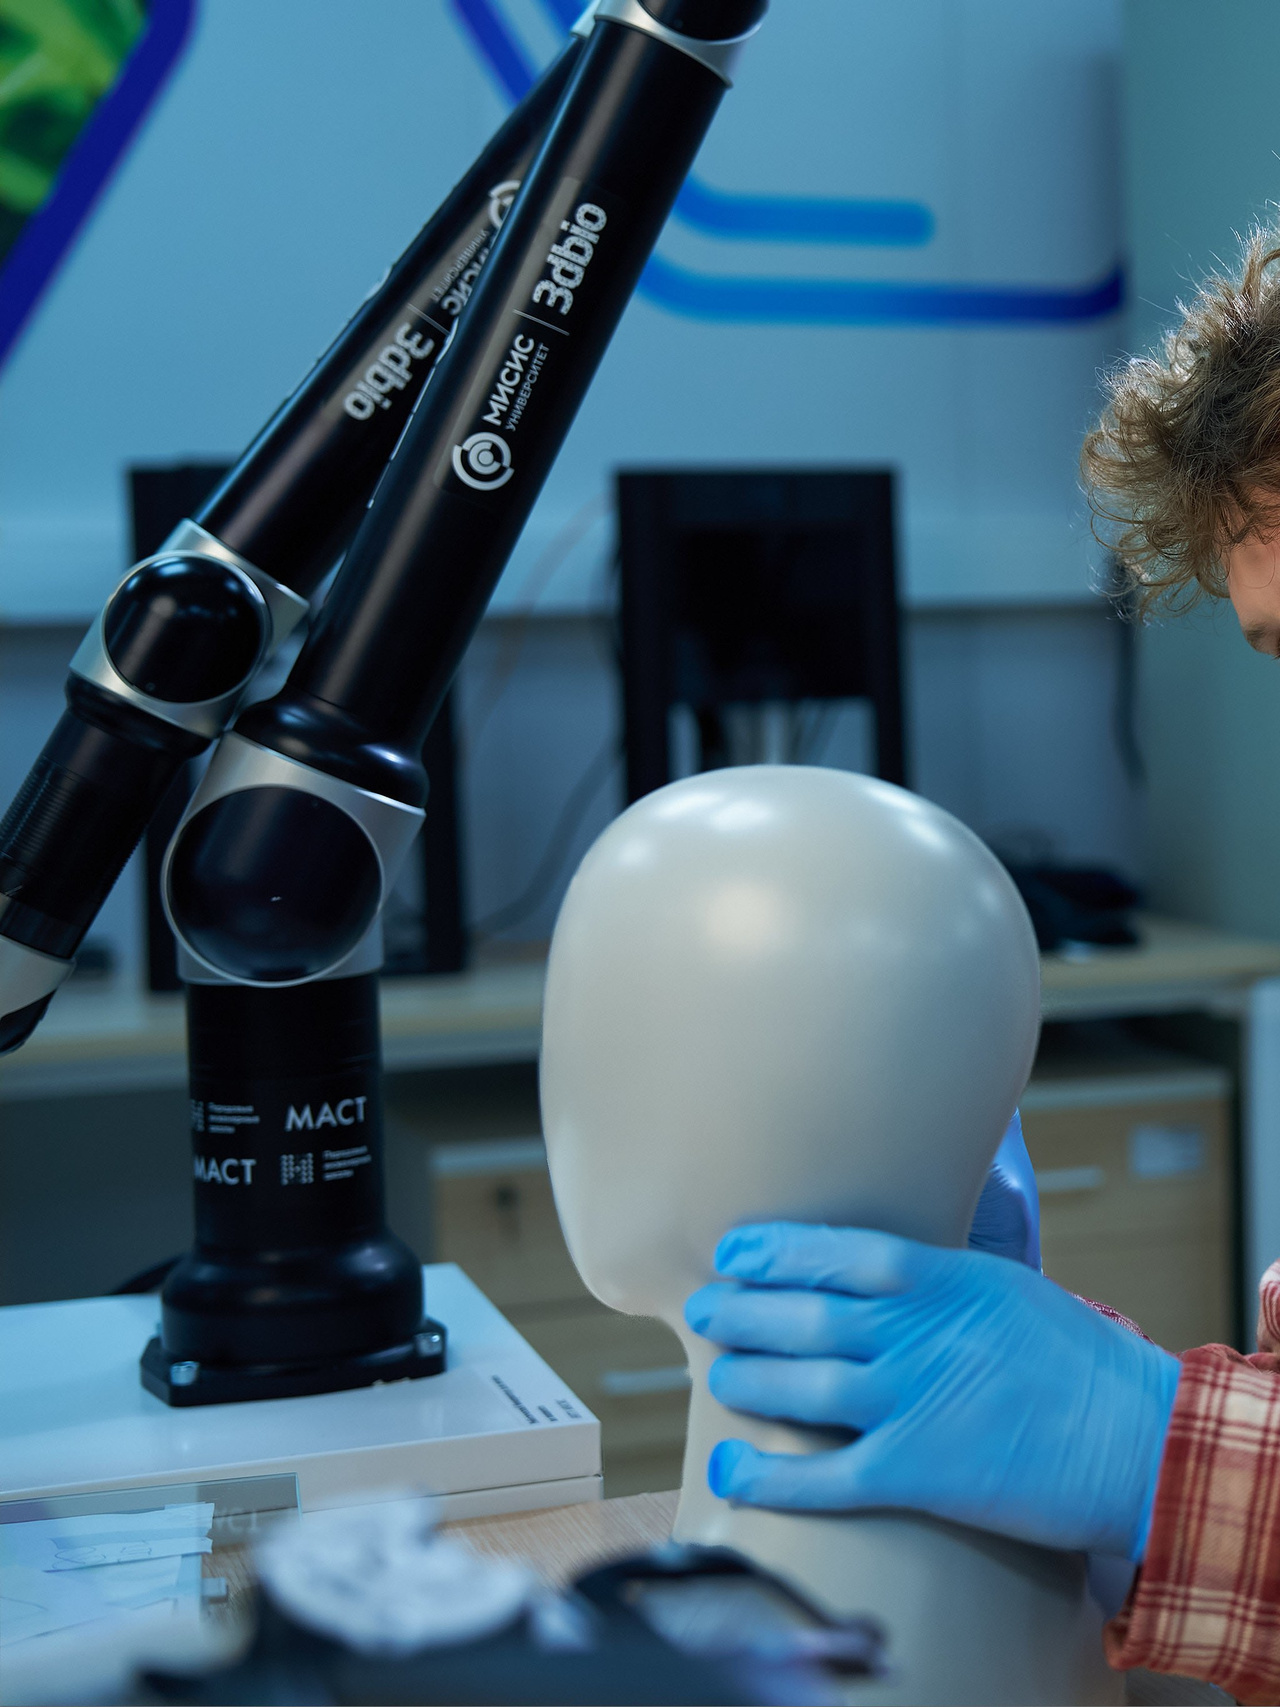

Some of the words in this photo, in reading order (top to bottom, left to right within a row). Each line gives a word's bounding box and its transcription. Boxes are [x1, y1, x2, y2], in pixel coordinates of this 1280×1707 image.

[533, 203, 607, 315] 3dbio
[343, 322, 435, 421] 3dbio
[482, 334, 534, 426] МИСИС
[505, 343, 549, 431] УНИВЕРСИТЕТ
